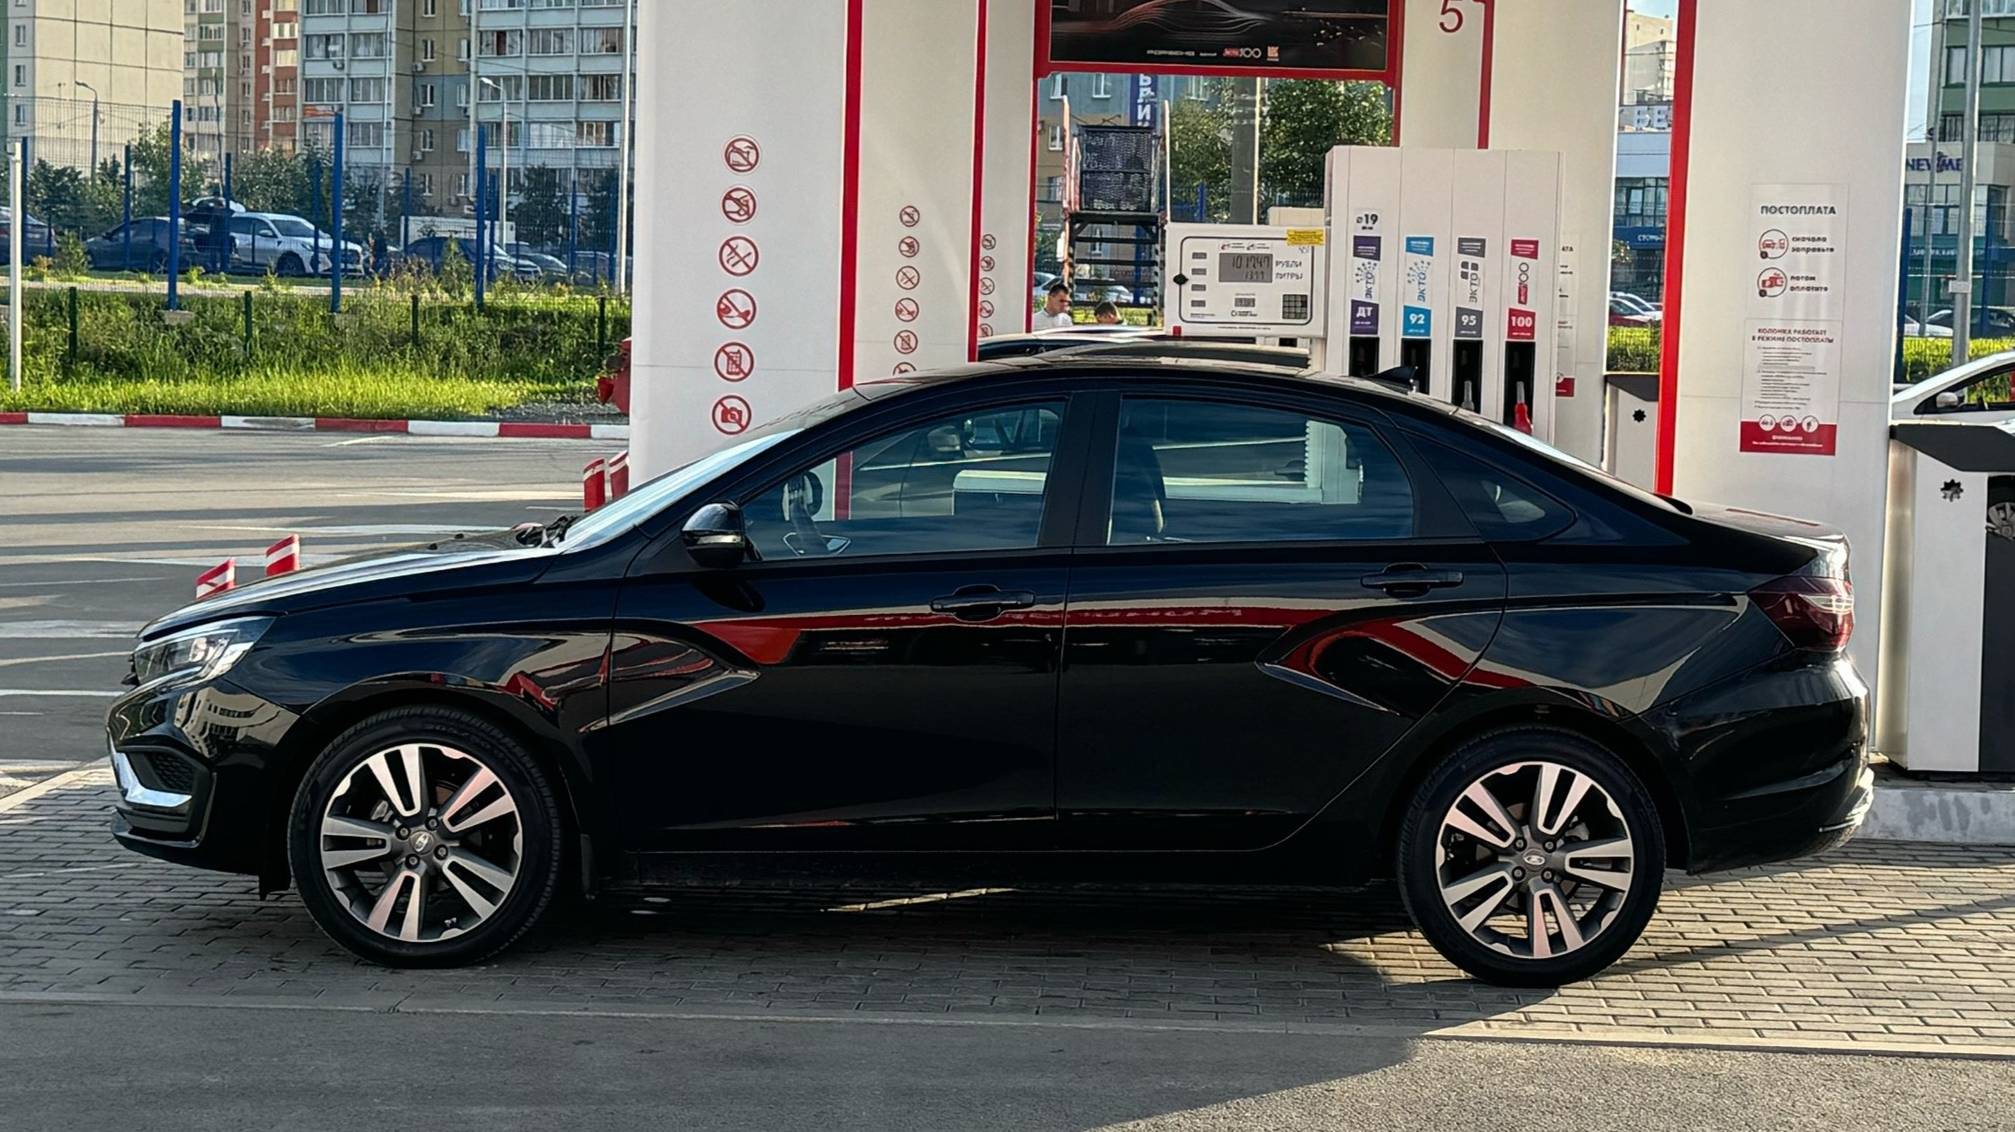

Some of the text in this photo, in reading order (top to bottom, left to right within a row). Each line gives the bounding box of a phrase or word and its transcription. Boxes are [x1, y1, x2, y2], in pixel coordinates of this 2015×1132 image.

[1440, 0, 1463, 33] 5
[1760, 205, 1836, 215] ПОСТОПЛАТА
[1356, 306, 1373, 318] ДТ
[1409, 313, 1425, 325] 92
[1461, 315, 1477, 326] 95
[1511, 316, 1533, 327] 100
